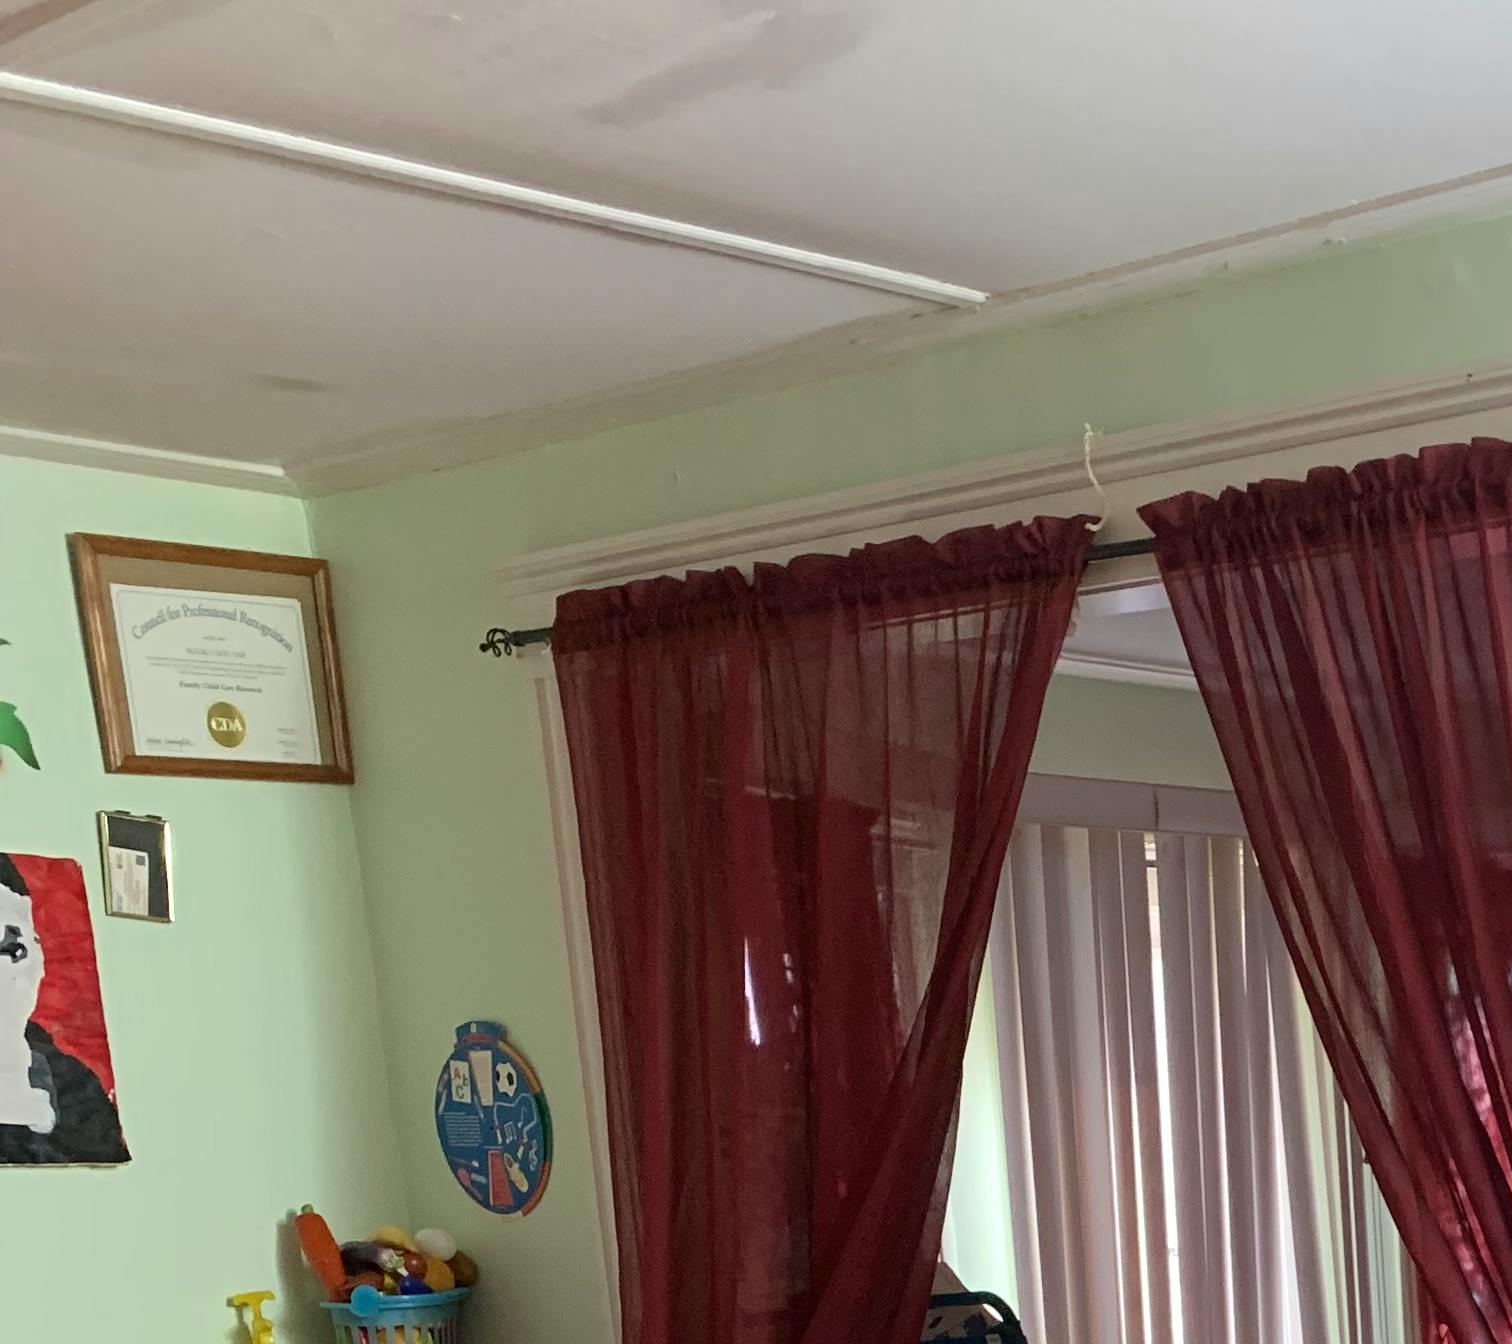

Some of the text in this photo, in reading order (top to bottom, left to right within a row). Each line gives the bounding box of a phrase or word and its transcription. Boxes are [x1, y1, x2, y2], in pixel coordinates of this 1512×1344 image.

[182, 603, 237, 621] Professional
[240, 610, 294, 653] Recognition
[211, 717, 243, 733] CDA
